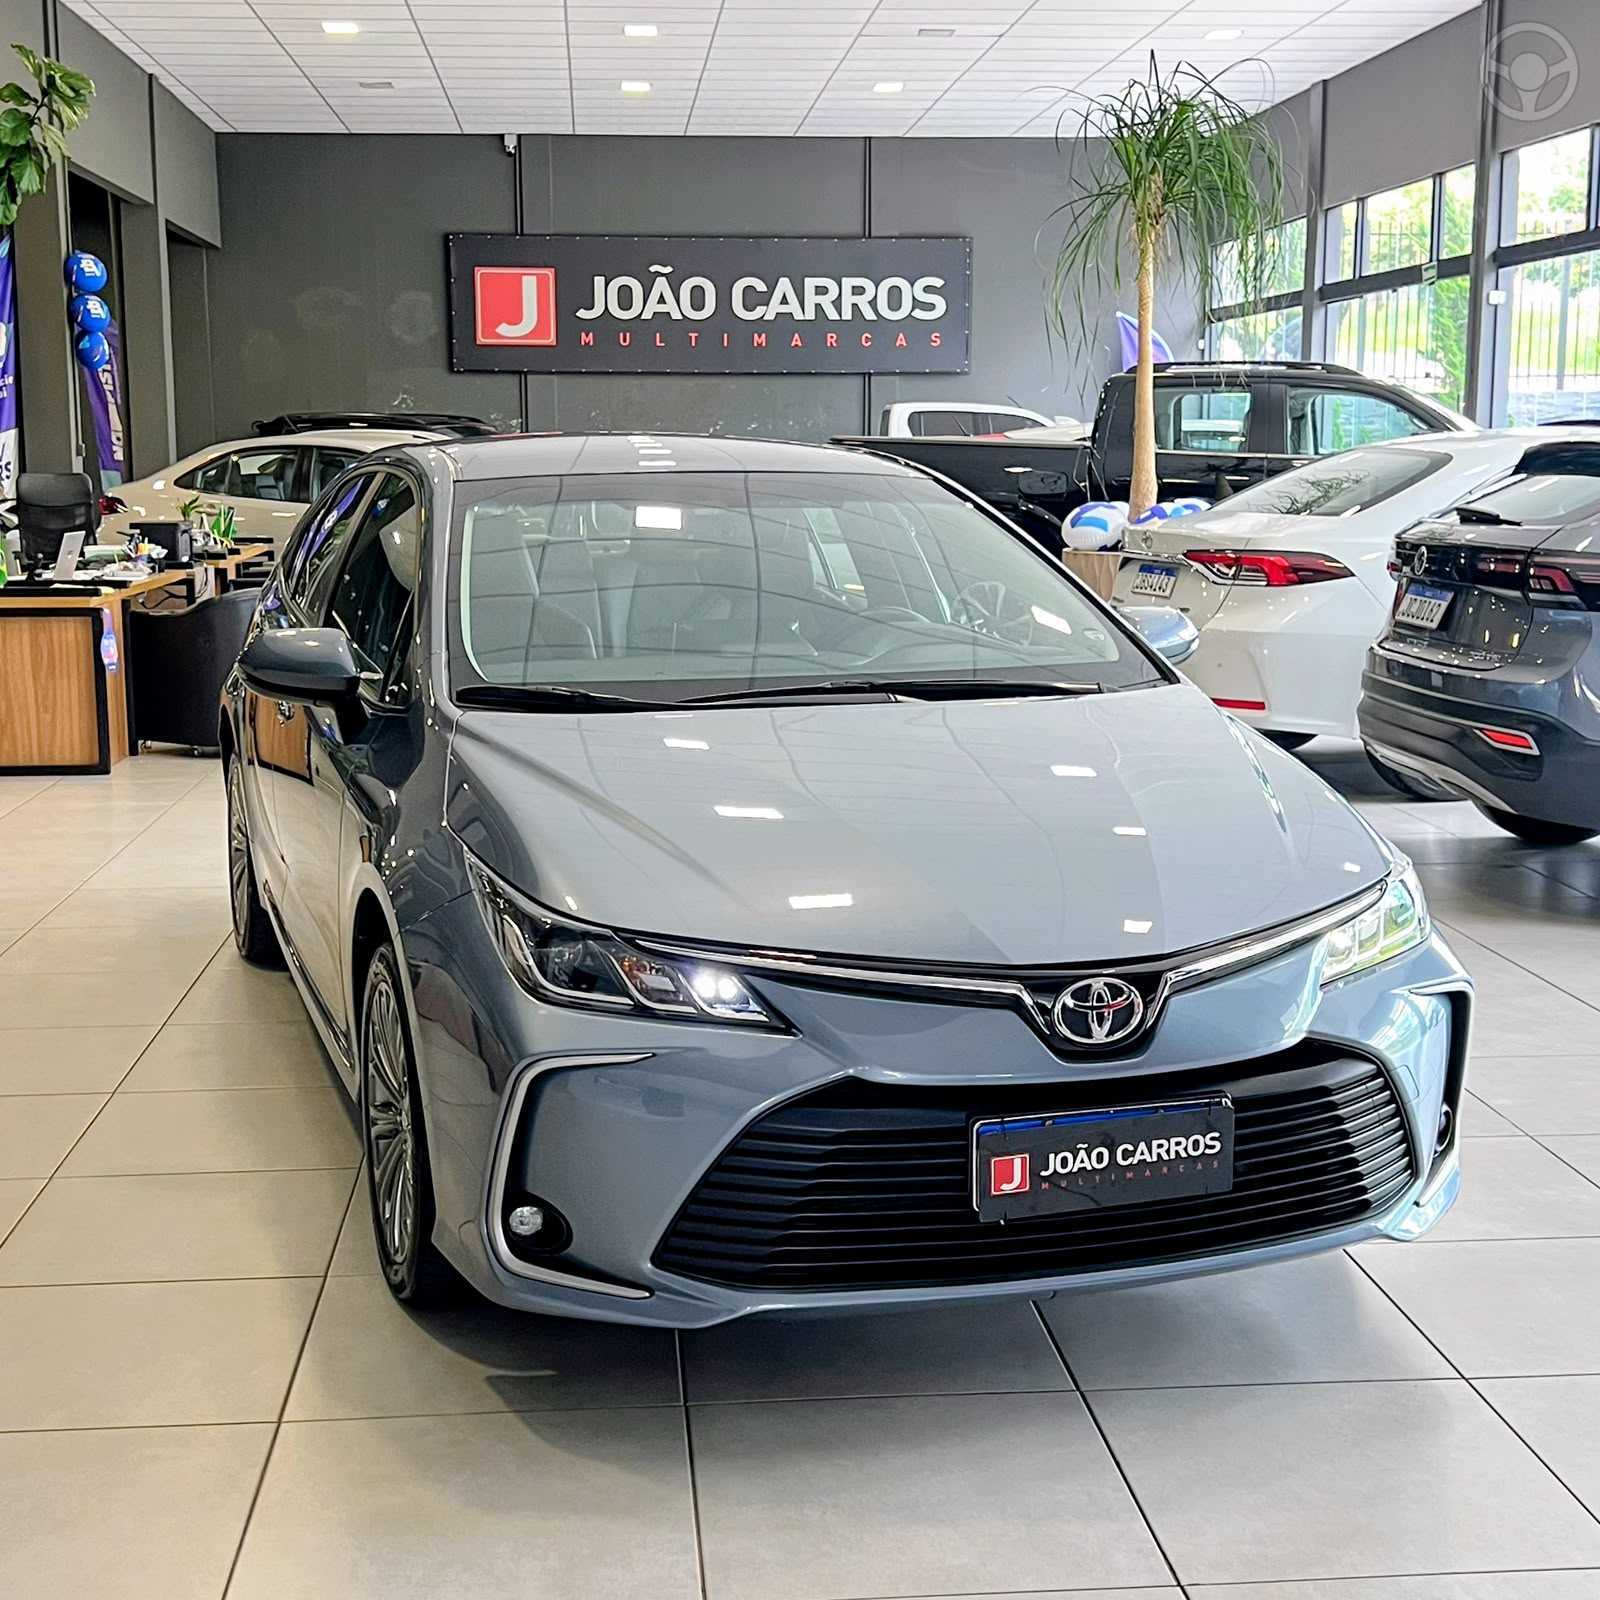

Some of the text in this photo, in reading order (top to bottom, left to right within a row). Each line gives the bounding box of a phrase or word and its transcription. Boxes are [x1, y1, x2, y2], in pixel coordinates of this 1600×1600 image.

[575, 264, 947, 321] JOÃO CARROS
[580, 332, 942, 348] MULTIMARCAS
[1040, 1131, 1222, 1177] JOÃO CARROS
[1041, 1160, 1219, 1190] MULTIMARCAS
